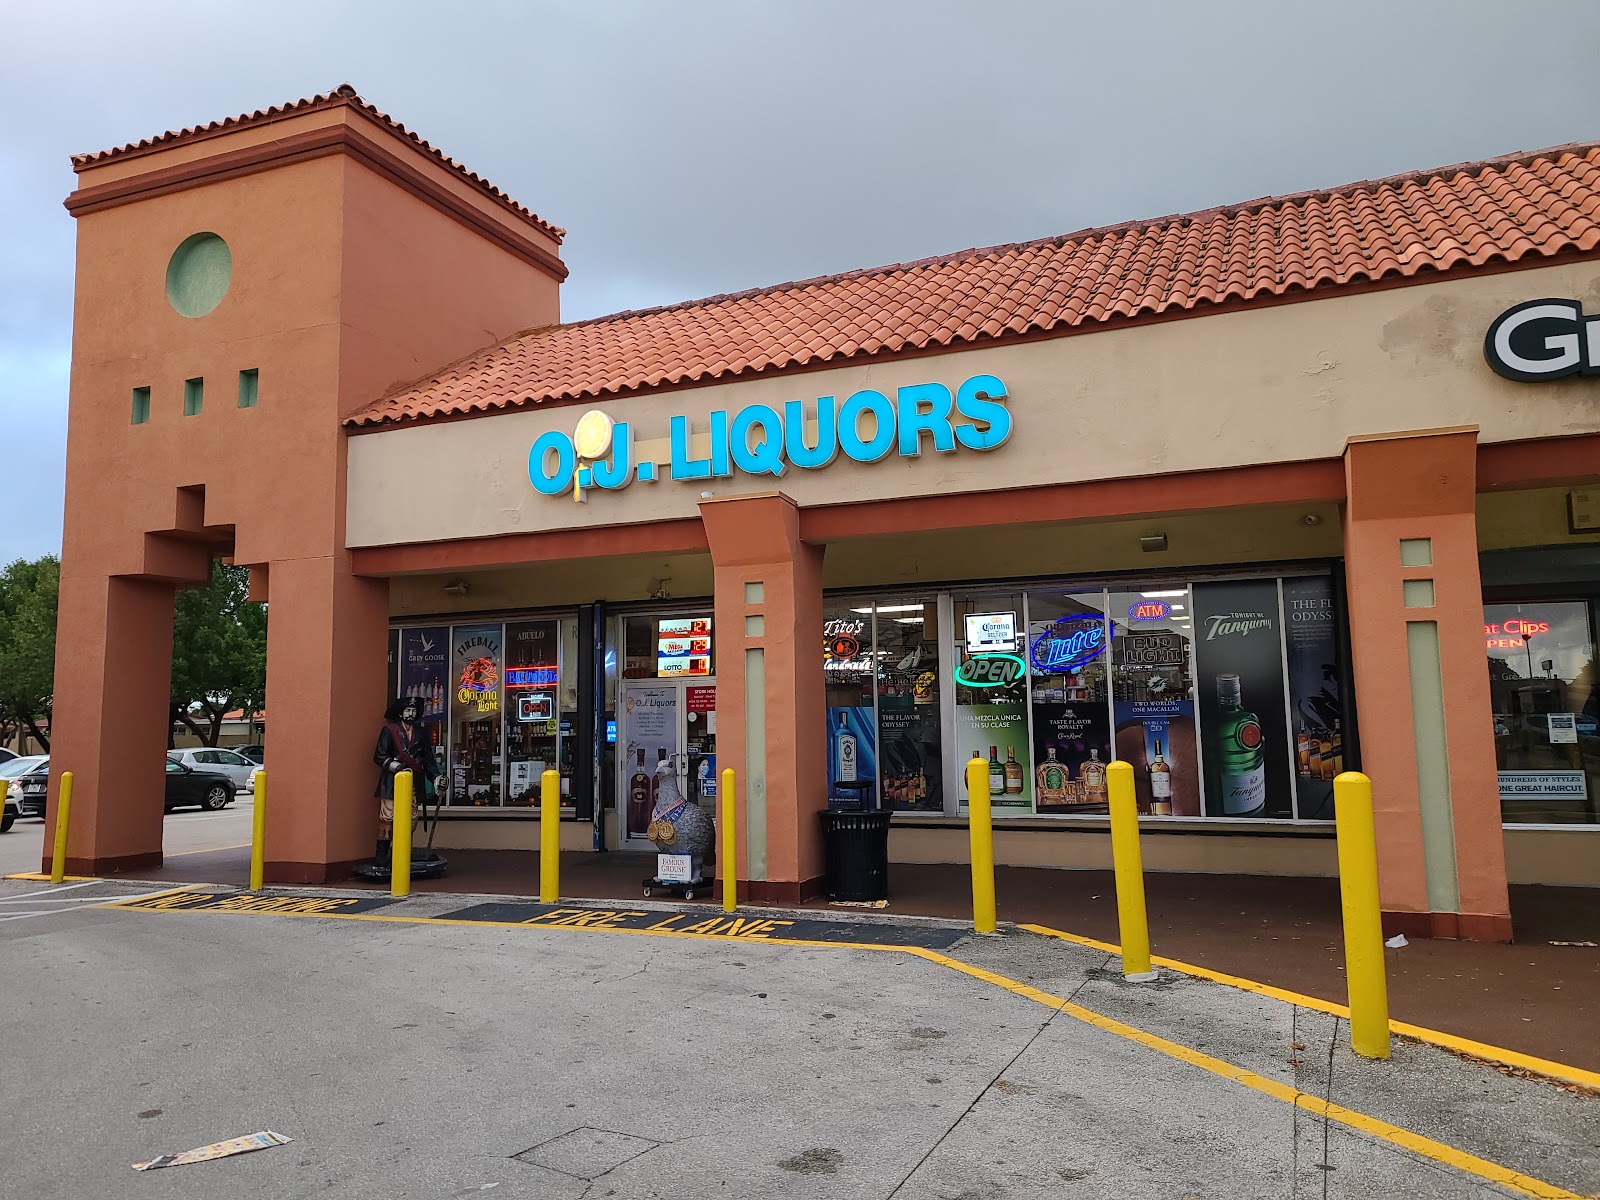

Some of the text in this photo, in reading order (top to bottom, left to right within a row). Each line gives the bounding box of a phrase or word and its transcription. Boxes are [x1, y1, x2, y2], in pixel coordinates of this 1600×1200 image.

[528, 374, 1014, 497] O.J. LIQUORS
[1291, 600, 1317, 609] THE
[1137, 605, 1163, 618] ATM
[824, 619, 865, 635] Tito's
[982, 622, 1010, 632] Corona
[1204, 615, 1272, 641] Tanqueray
[1502, 619, 1549, 636] Clips
[517, 631, 545, 640] ABUELO
[457, 636, 499, 657] FIREBALL
[693, 640, 707, 651] 129
[1133, 636, 1171, 650] BUD
[508, 670, 554, 684] BACARDI
[960, 659, 1018, 682] OPEN
[458, 688, 498, 704] Corona
[477, 700, 498, 712] Light
[523, 703, 547, 714] OPEN
[636, 699, 676, 708] O.J. Liquors
[662, 858, 685, 866] FAMOUS
[661, 865, 686, 873] GROUSE
[520, 908, 797, 939] FIRE LANE
